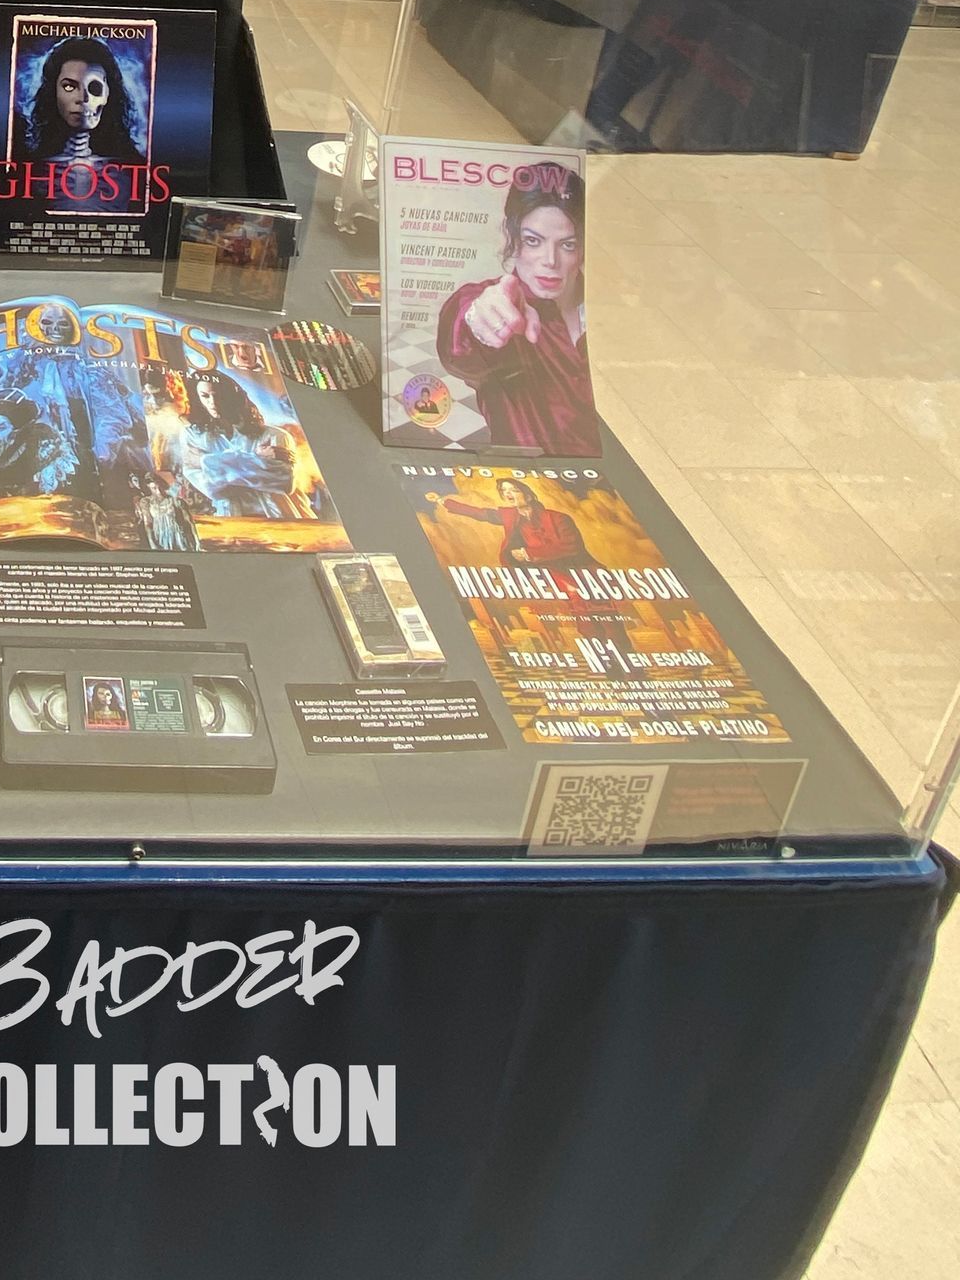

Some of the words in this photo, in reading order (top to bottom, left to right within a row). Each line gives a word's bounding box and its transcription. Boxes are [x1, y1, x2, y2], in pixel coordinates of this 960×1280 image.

[22, 24, 84, 38] MICHAEL
[87, 26, 147, 40] JACKSON
[400, 207, 406, 219] 5
[409, 208, 441, 221] NUEVAS
[444, 210, 489, 224] CANCIONES
[422, 222, 431, 231] DE
[400, 243, 435, 257] VINCENT
[437, 246, 477, 260] PATERSON
[400, 278, 414, 289] LOS
[416, 279, 456, 292] VIDEOCLIPS
[400, 311, 429, 322] REMIXES
[93, 360, 153, 372] MICHAEL
[161, 367, 220, 384] JACKSON
[401, 465, 493, 479] NUEVO
[511, 467, 600, 480] DISCO
[448, 565, 569, 601] MICHAEL
[570, 566, 690, 601] JACKSON
[509, 651, 578, 669] TRIPLE
[627, 652, 652, 667] EN
[652, 648, 714, 667] ESPAÑA
[519, 680, 560, 690] ENTRADA
[560, 681, 599, 690] DIRECTA
[599, 681, 611, 690] AL
[629, 681, 641, 690] DE
[642, 680, 702, 689] SUPERVENTAS
[545, 691, 555, 700] SE
[560, 691, 602, 700] MANTIENE
[621, 691, 682, 700] SUPERVENTAS
[683, 690, 720, 699] SINGLES
[566, 702, 578, 711] DE
[581, 701, 640, 712] POPULARIDAD
[643, 702, 655, 711] EN
[657, 701, 686, 710] LISTAS
[689, 701, 701, 710] DE
[702, 700, 730, 709] RADIO
[535, 720, 601, 738] CAMINO
[607, 721, 639, 738] DEL
[642, 720, 697, 738] DOBLE
[700, 719, 769, 737] PLATINO
